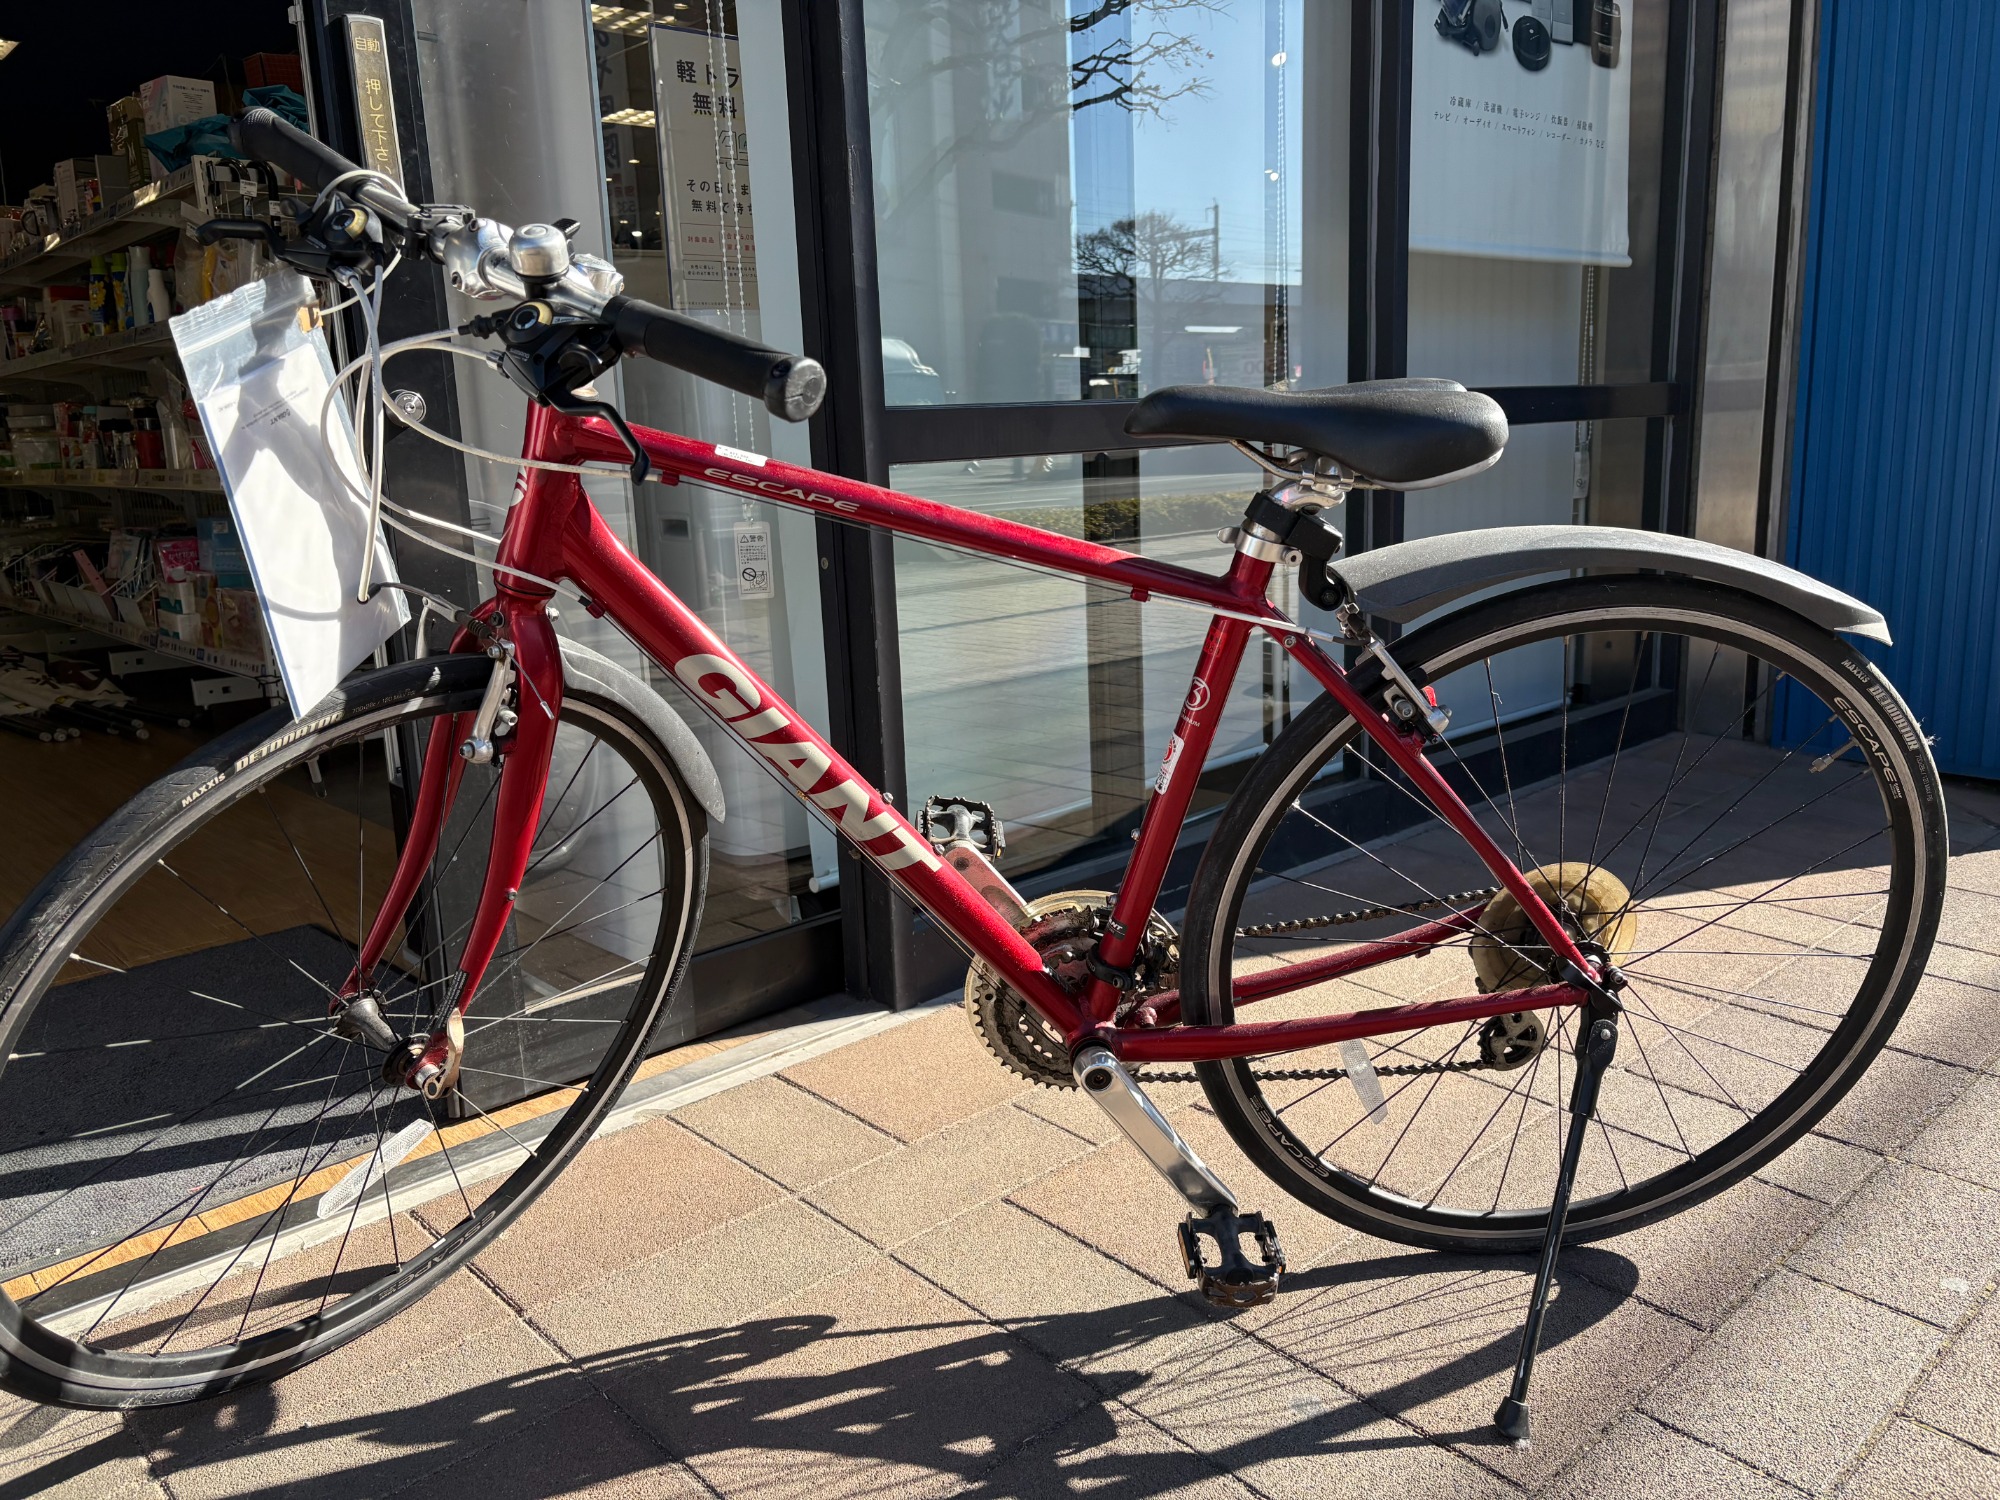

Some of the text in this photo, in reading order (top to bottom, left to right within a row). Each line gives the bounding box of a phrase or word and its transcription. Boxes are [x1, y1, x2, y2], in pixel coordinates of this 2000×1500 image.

[355, 37, 380, 52] 自動
[677, 59, 739, 88] 軽トラ
[693, 92, 737, 119] 無料
[1450, 96, 1471, 109] 冷蔵庫
[1484, 102, 1502, 114] 洗濯機
[1513, 108, 1540, 120] 電子レンジ
[1434, 111, 1450, 121] テレビ
[1464, 116, 1491, 128] オーディオ
[1502, 124, 1536, 136] スマートフォン
[1580, 137, 1593, 146] カメラ
[704, 468, 860, 513] ESCAPE
[1841, 659, 1871, 684] MAXXIS
[1834, 696, 1897, 782] ESCAPE
[182, 772, 226, 808] MAXXIS
[234, 709, 345, 774] DETONATOR
[674, 653, 943, 872] GIANT
[1257, 1111, 1329, 1178] ESCAPE
